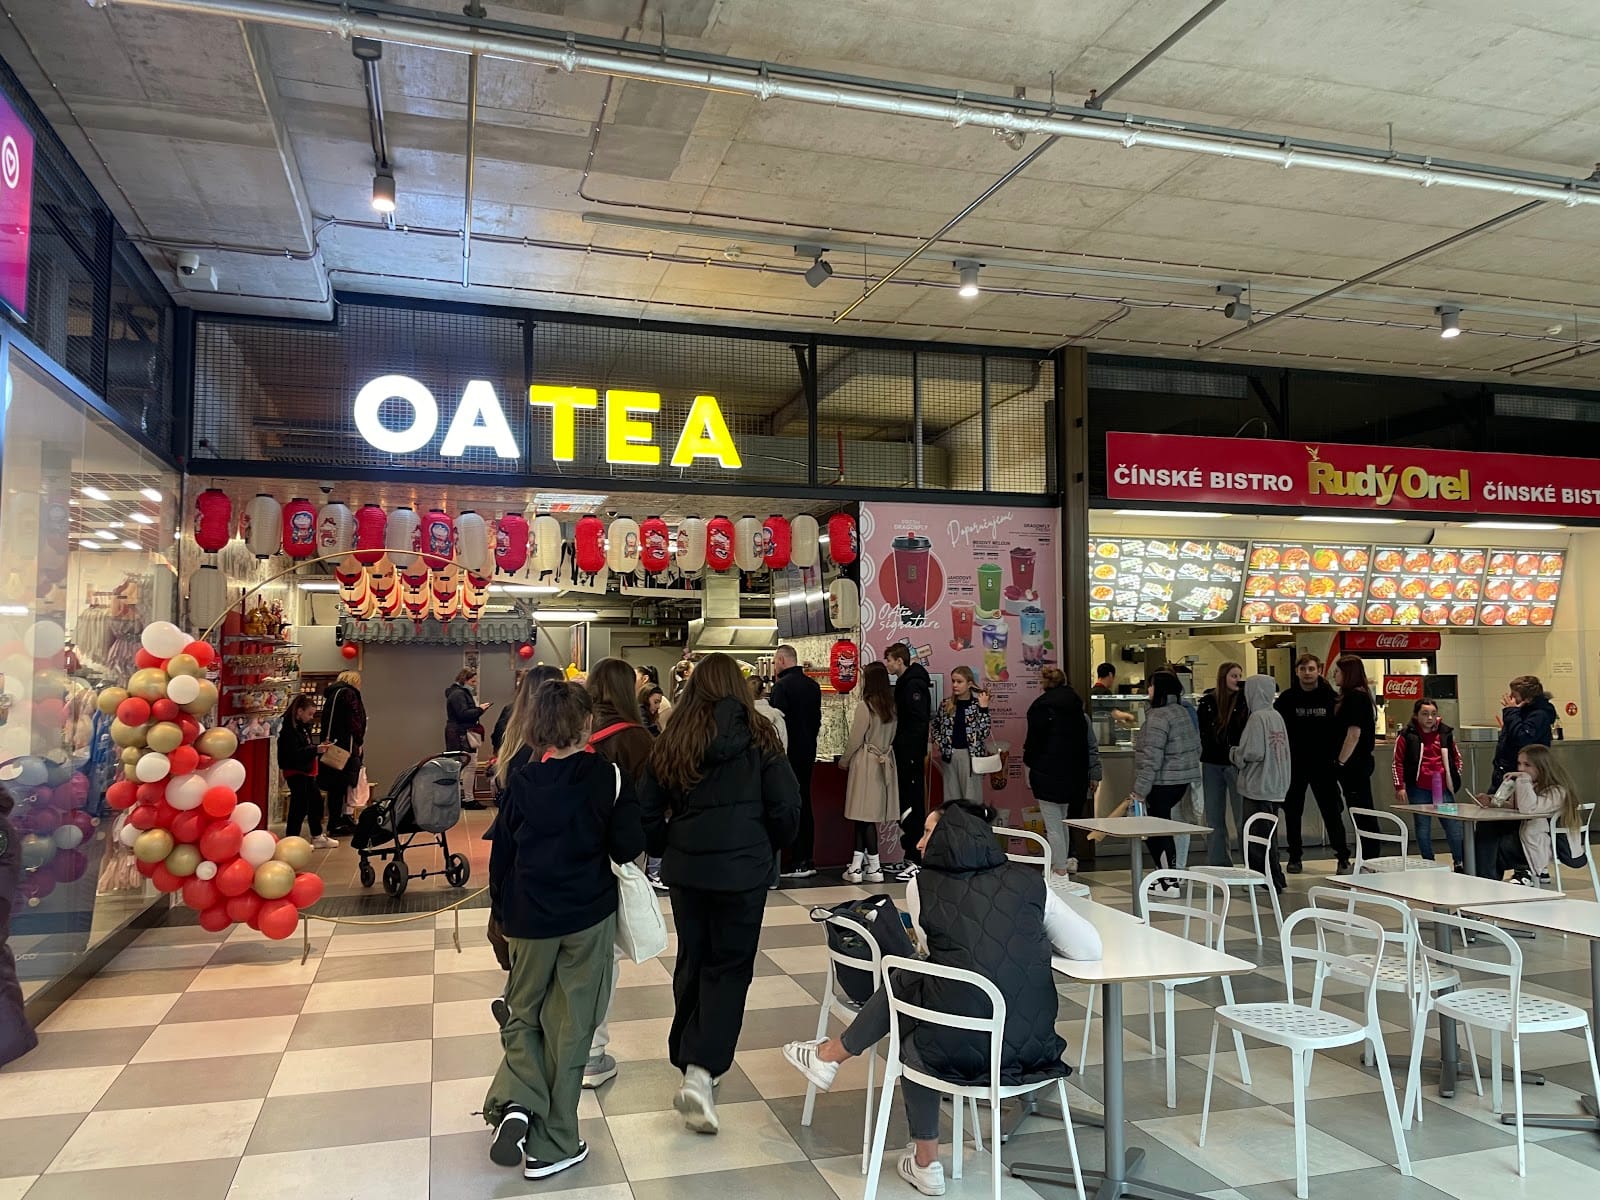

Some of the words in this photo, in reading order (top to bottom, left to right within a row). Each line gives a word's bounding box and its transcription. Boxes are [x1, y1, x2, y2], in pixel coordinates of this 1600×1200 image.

[1113, 463, 1203, 488] ČÍNSKÉ
[1210, 471, 1294, 492] BISTRO
[1308, 461, 1398, 506] Rudý
[1401, 466, 1470, 501] Orel
[1482, 481, 1557, 503] ČÍNSKÉ
